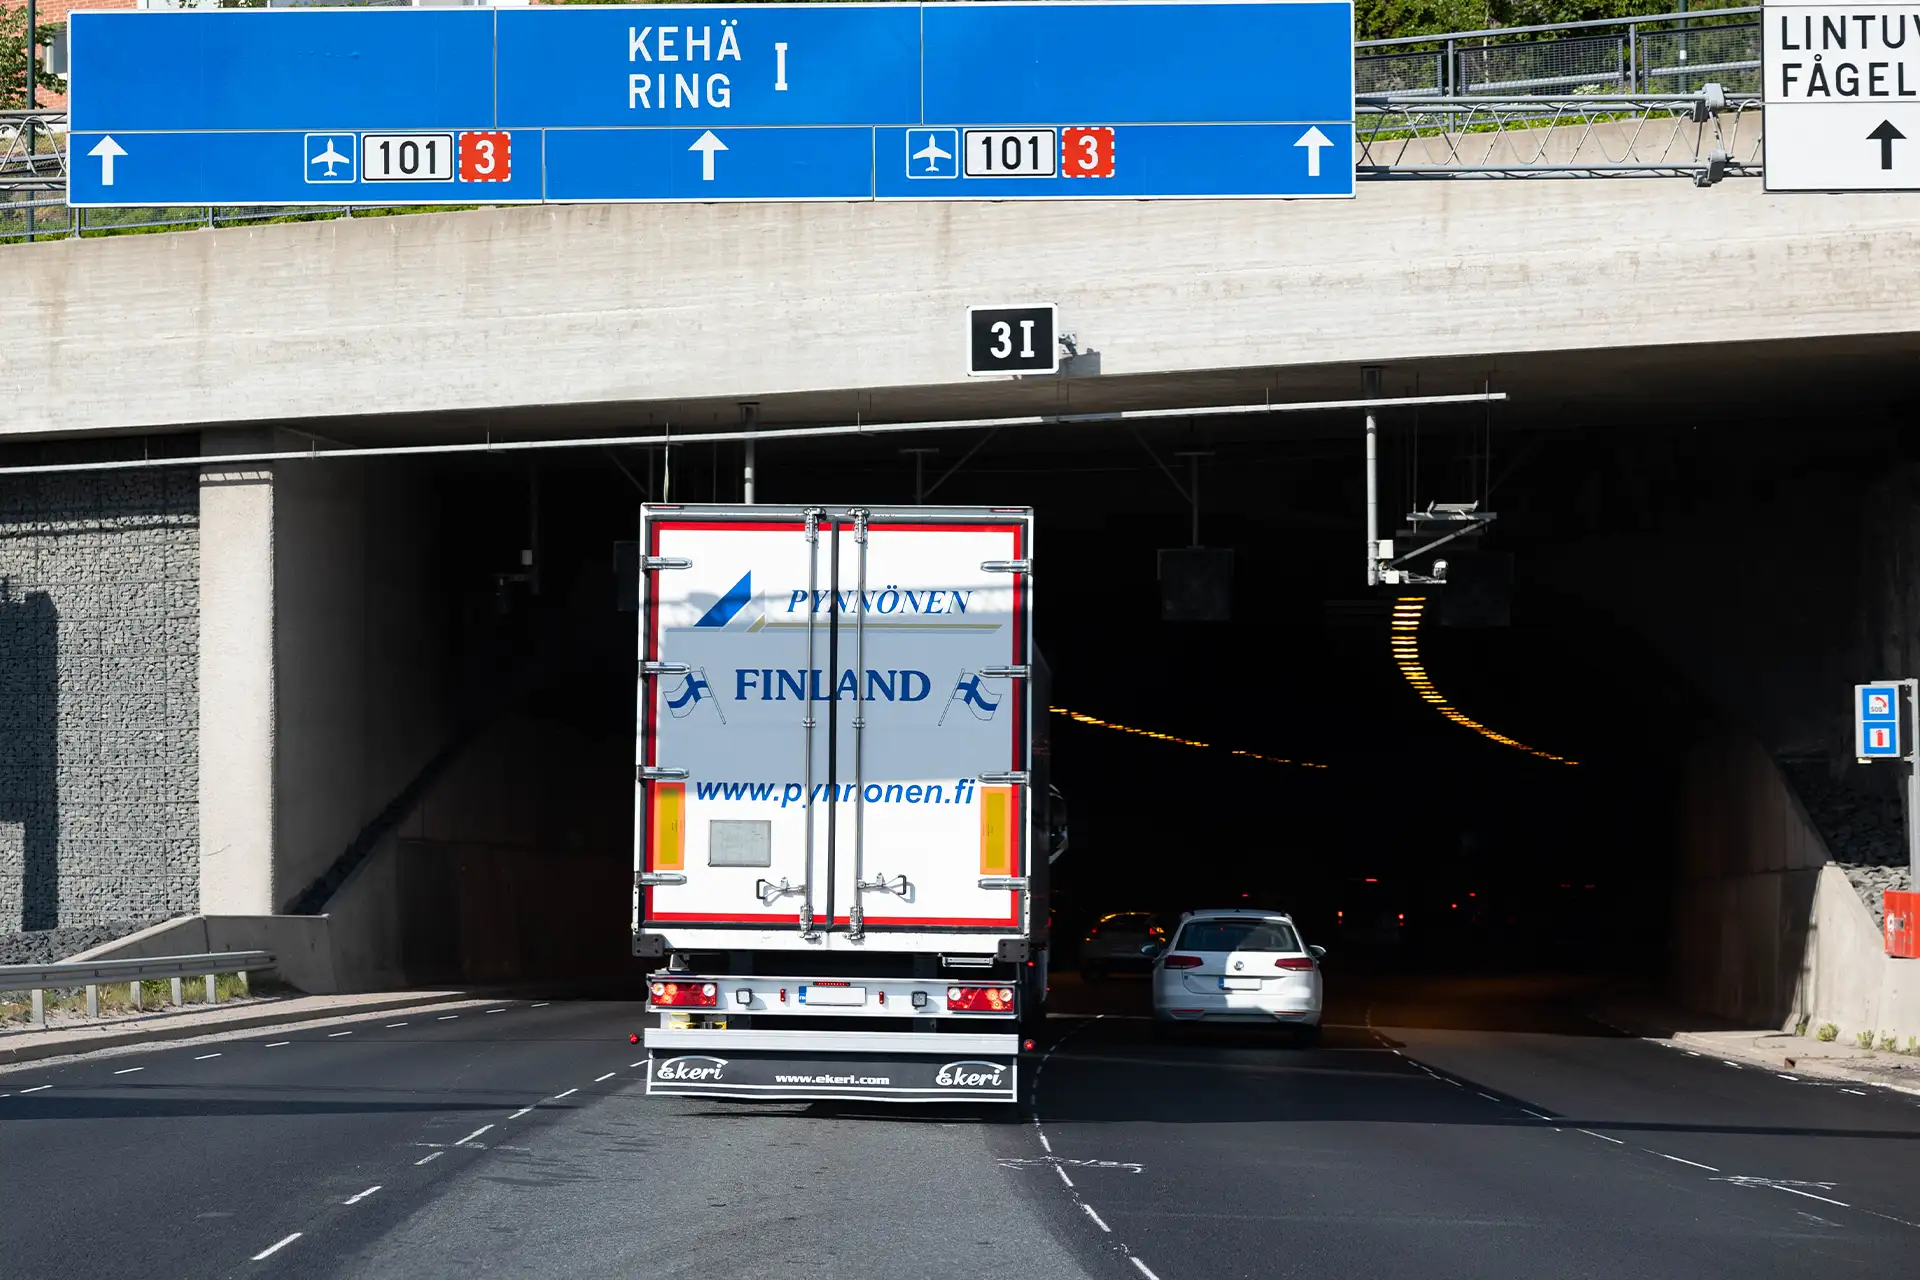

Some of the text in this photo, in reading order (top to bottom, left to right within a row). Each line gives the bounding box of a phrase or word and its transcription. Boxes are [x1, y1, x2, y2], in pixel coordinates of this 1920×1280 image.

[629, 19, 742, 62] KEHÄ
[775, 42, 788, 91] I
[629, 73, 731, 109] RING
[380, 140, 436, 175] 101
[474, 139, 496, 175] 3
[981, 135, 1039, 171] 101
[1077, 135, 1099, 170] 3
[786, 584, 972, 616] PYNNÖNEN
[734, 667, 932, 702] FINLAND
[657, 1056, 727, 1081] Ekeri
[774, 1074, 890, 1085] www.ekeri.com
[935, 1061, 1006, 1086] Ekeri
